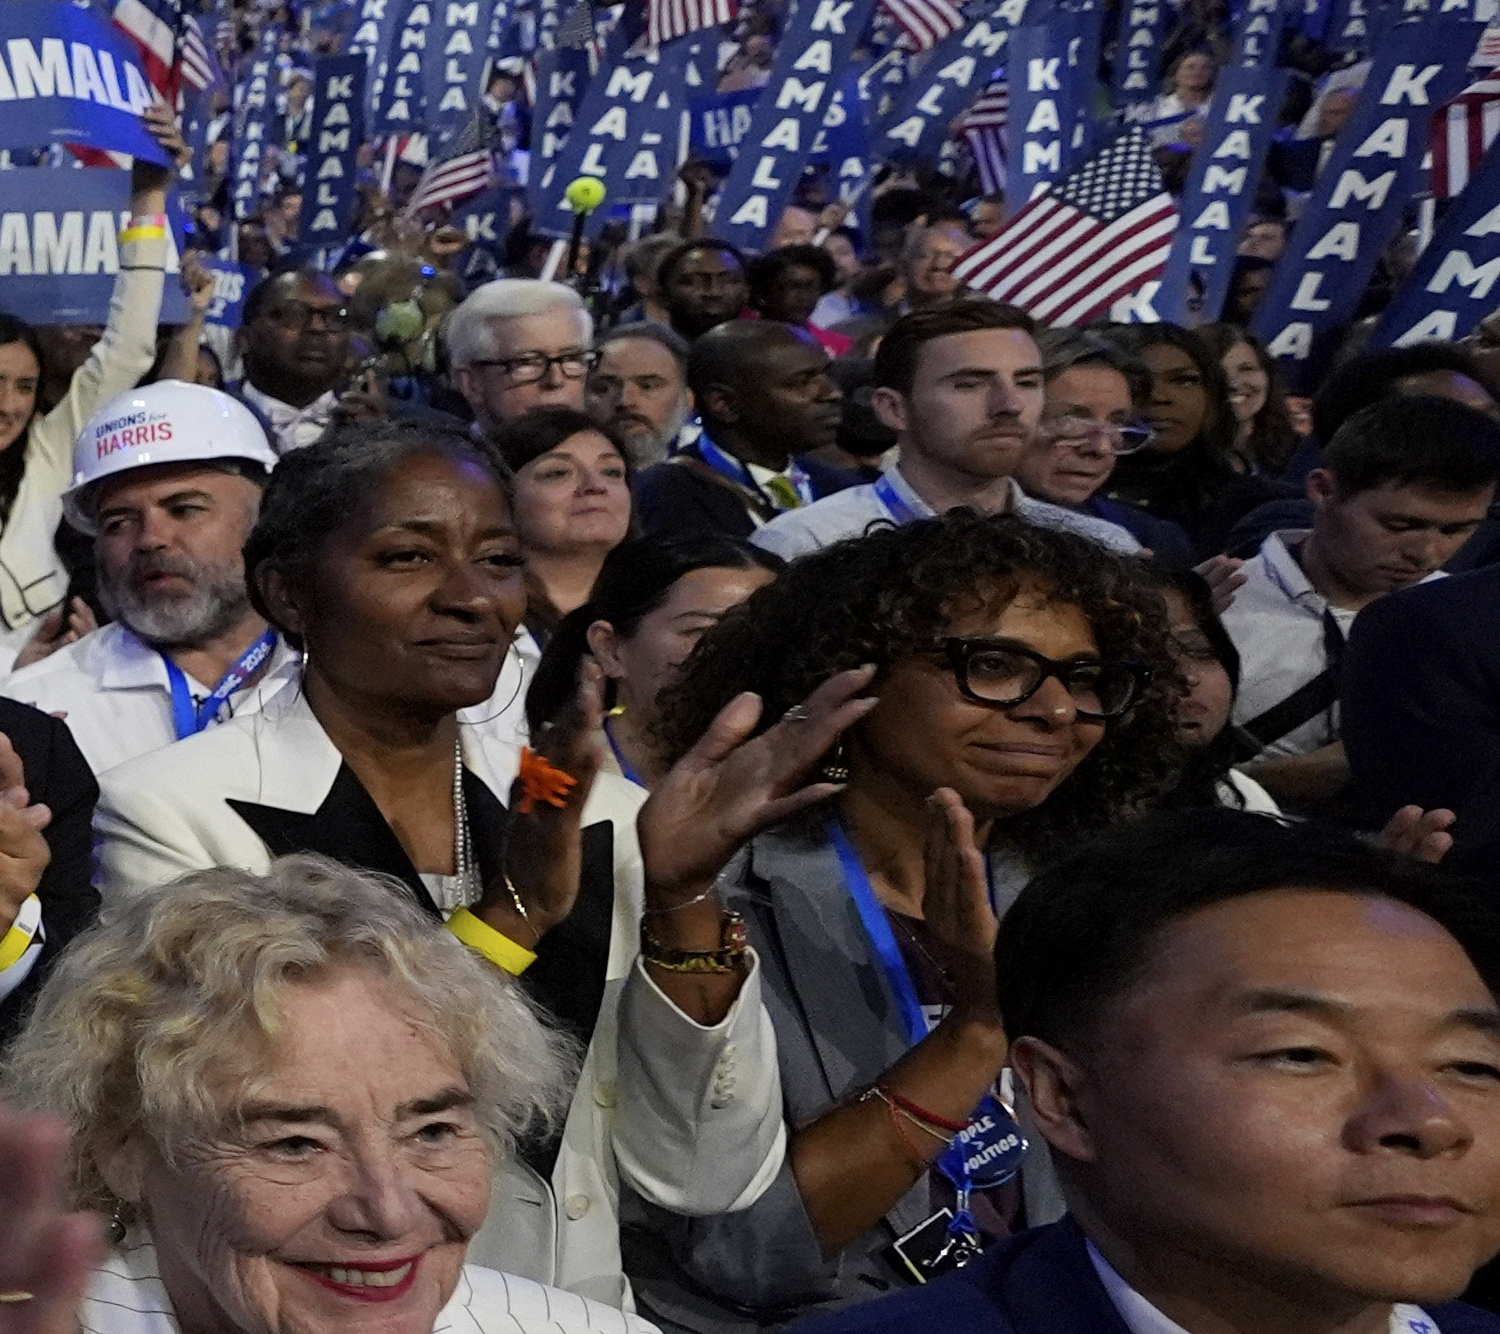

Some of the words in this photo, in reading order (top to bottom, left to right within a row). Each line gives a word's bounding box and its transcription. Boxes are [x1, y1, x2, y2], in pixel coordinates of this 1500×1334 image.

[311, 74, 353, 230] KAMALA
[731, 0, 854, 228] KAMALA
[1191, 92, 1266, 265] KAMAL
[1270, 63, 1441, 360] KAMALA
[96, 422, 173, 458] HARRIS
